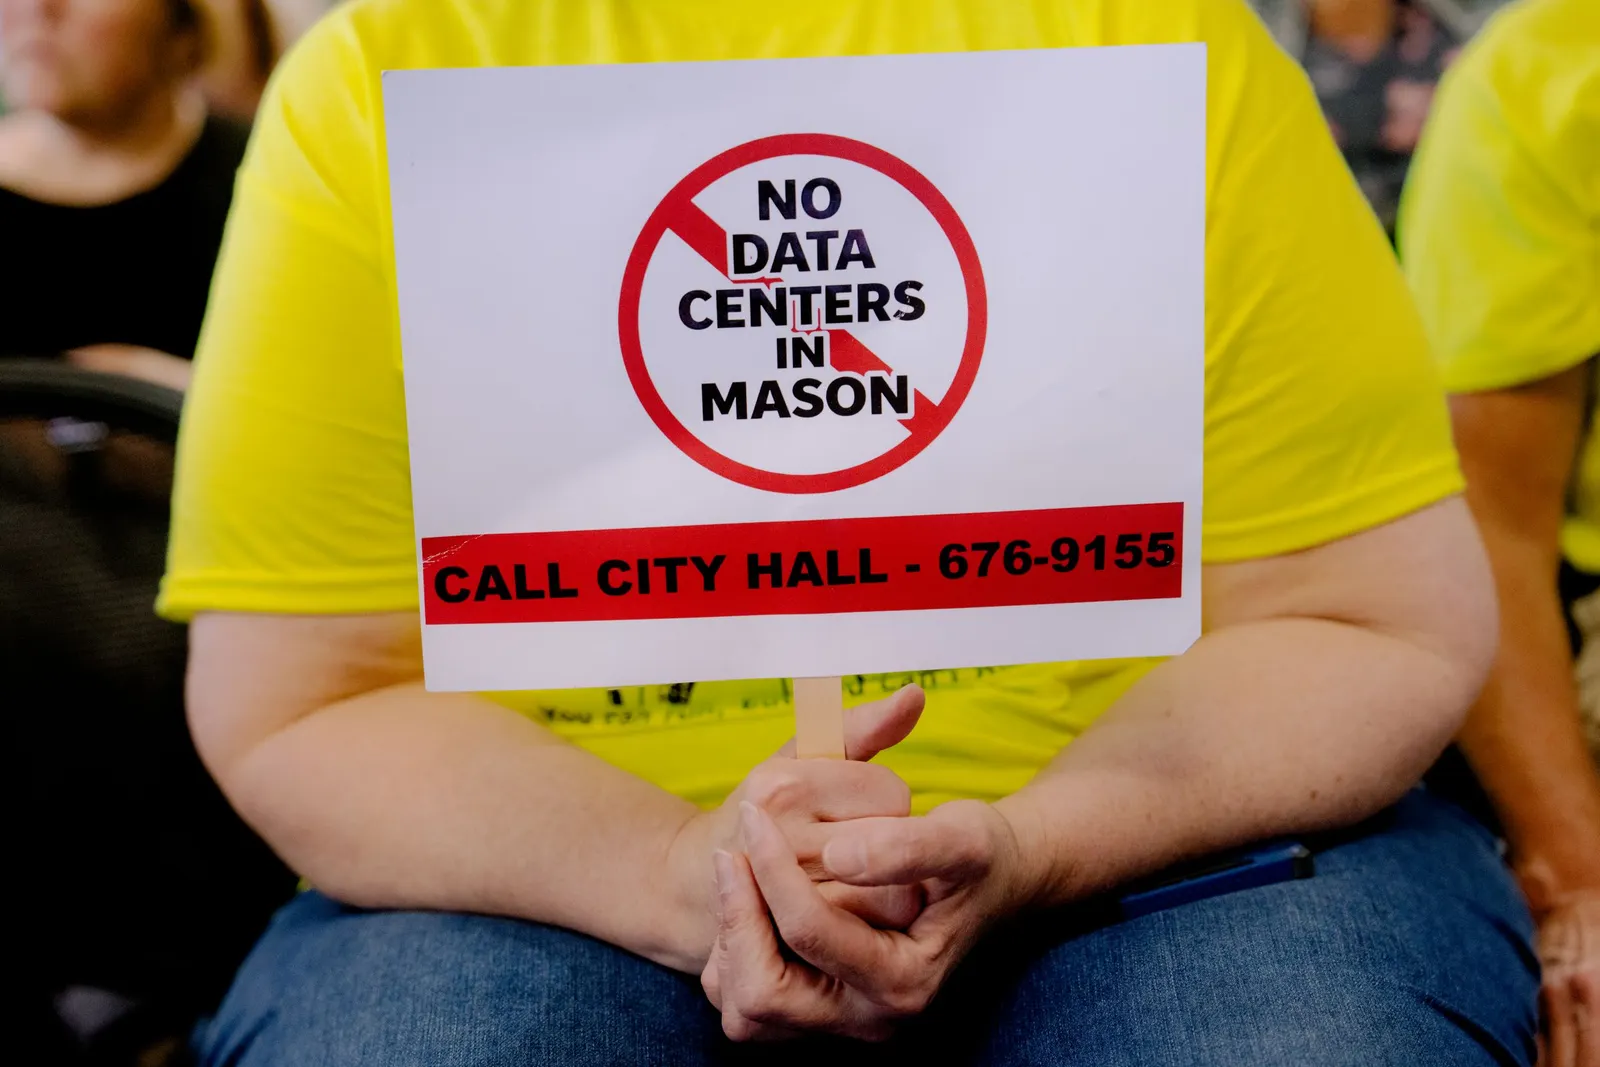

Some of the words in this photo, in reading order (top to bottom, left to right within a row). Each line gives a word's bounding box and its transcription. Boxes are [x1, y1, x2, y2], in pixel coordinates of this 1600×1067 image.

[758, 178, 841, 220] NO
[733, 230, 875, 274] DATA
[679, 281, 925, 330] CENTERS
[777, 336, 824, 368] IN
[702, 376, 908, 421] MASON
[435, 563, 578, 603] CALL
[598, 555, 726, 596] CITY
[748, 548, 888, 589] HALL
[905, 563, 921, 573] -
[939, 532, 1175, 579] 676-9155
